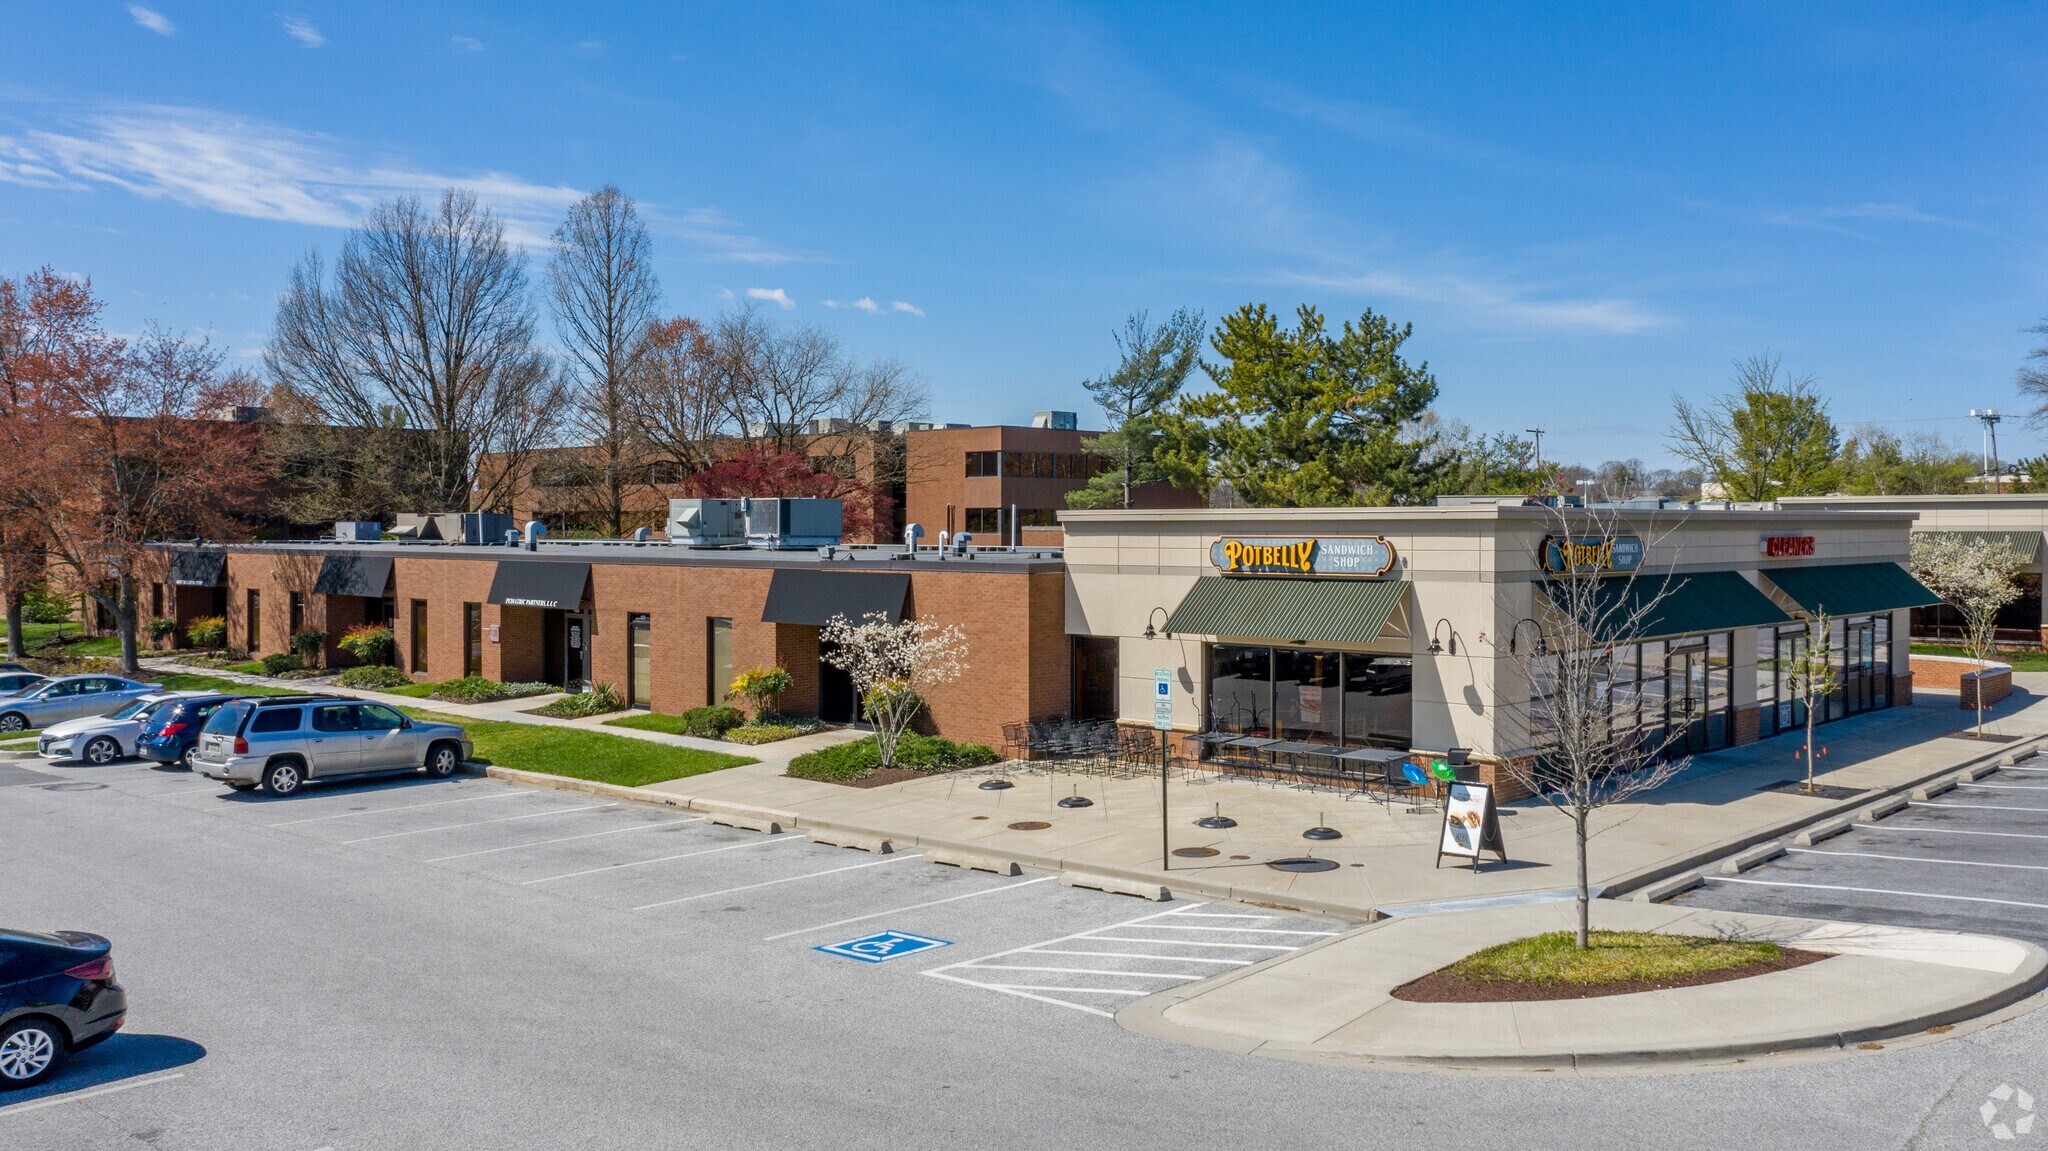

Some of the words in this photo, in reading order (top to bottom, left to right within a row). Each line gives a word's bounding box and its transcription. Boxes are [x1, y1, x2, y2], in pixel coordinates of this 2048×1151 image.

[1321, 544, 1373, 556] SANDWICH
[1613, 543, 1639, 554] SANDWICH
[1771, 537, 1816, 556] CLEANERS
[1224, 539, 1316, 571] POTBELLY
[1618, 554, 1632, 565] SHOP
[1333, 556, 1360, 567] SHOP
